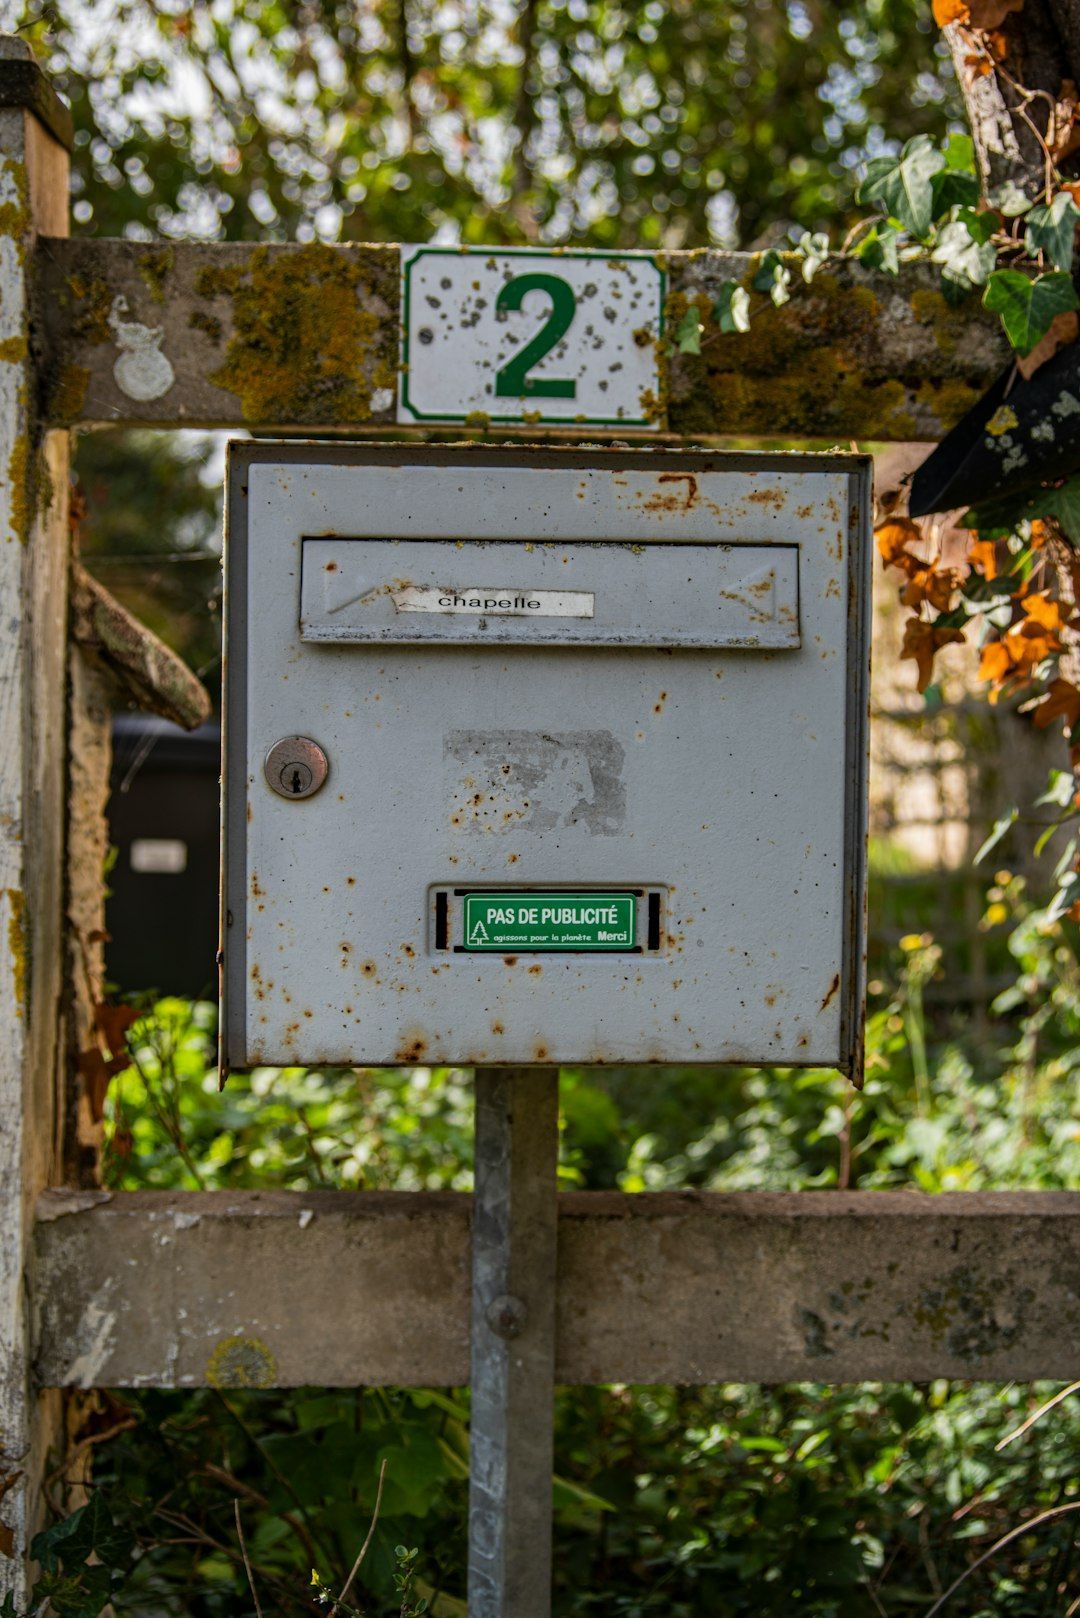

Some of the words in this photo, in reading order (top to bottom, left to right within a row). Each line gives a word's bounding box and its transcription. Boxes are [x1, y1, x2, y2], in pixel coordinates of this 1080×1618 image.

[495, 272, 577, 399] 2
[438, 595, 541, 611] chapelle
[487, 908, 515, 925] PAS
[519, 908, 538, 925] DE
[541, 904, 618, 925] PUBLICITÉ
[493, 934, 528, 943] agissons
[551, 933, 560, 942] la
[561, 933, 592, 943] planète
[597, 931, 627, 942] Merci
